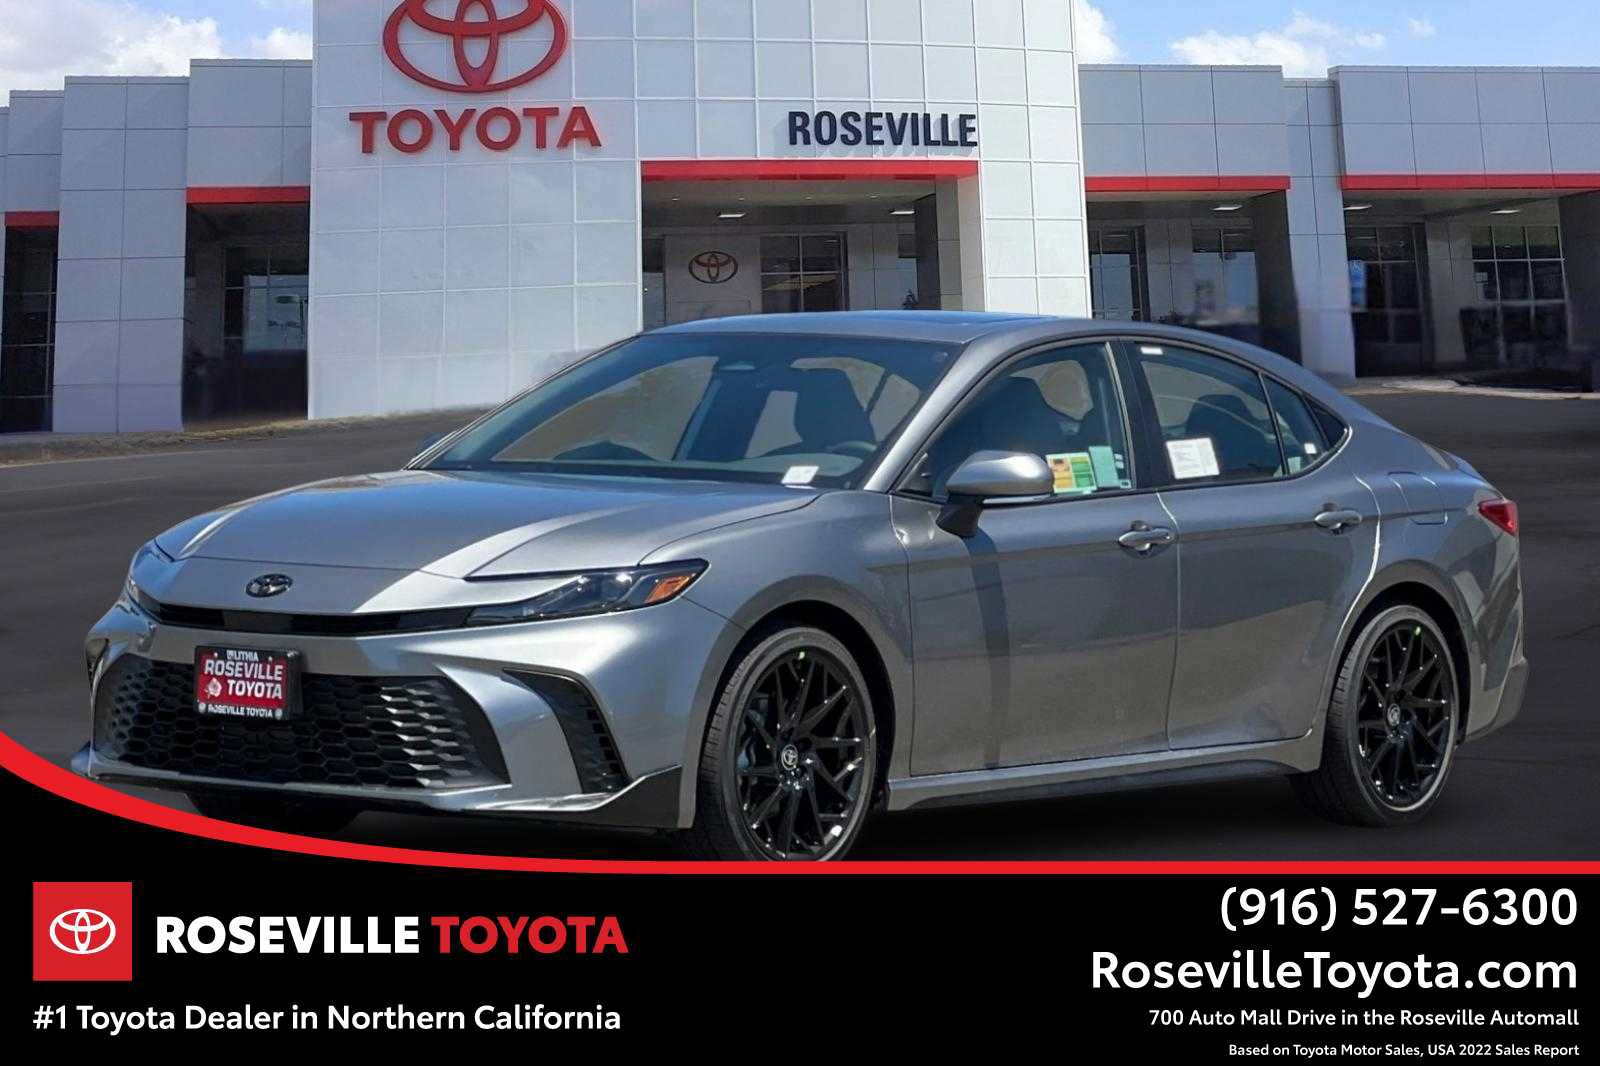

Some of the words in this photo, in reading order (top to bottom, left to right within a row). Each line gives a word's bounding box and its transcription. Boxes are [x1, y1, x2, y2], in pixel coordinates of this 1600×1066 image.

[349, 106, 602, 154] TOYOTA
[788, 110, 978, 148] ROSEVILLE
[234, 650, 259, 662] LITHIA
[204, 659, 284, 681] ROSEVILLE
[227, 679, 283, 699] TOYOTA
[207, 704, 245, 716] ROSEVILLE
[246, 707, 273, 718] TOYOTA
